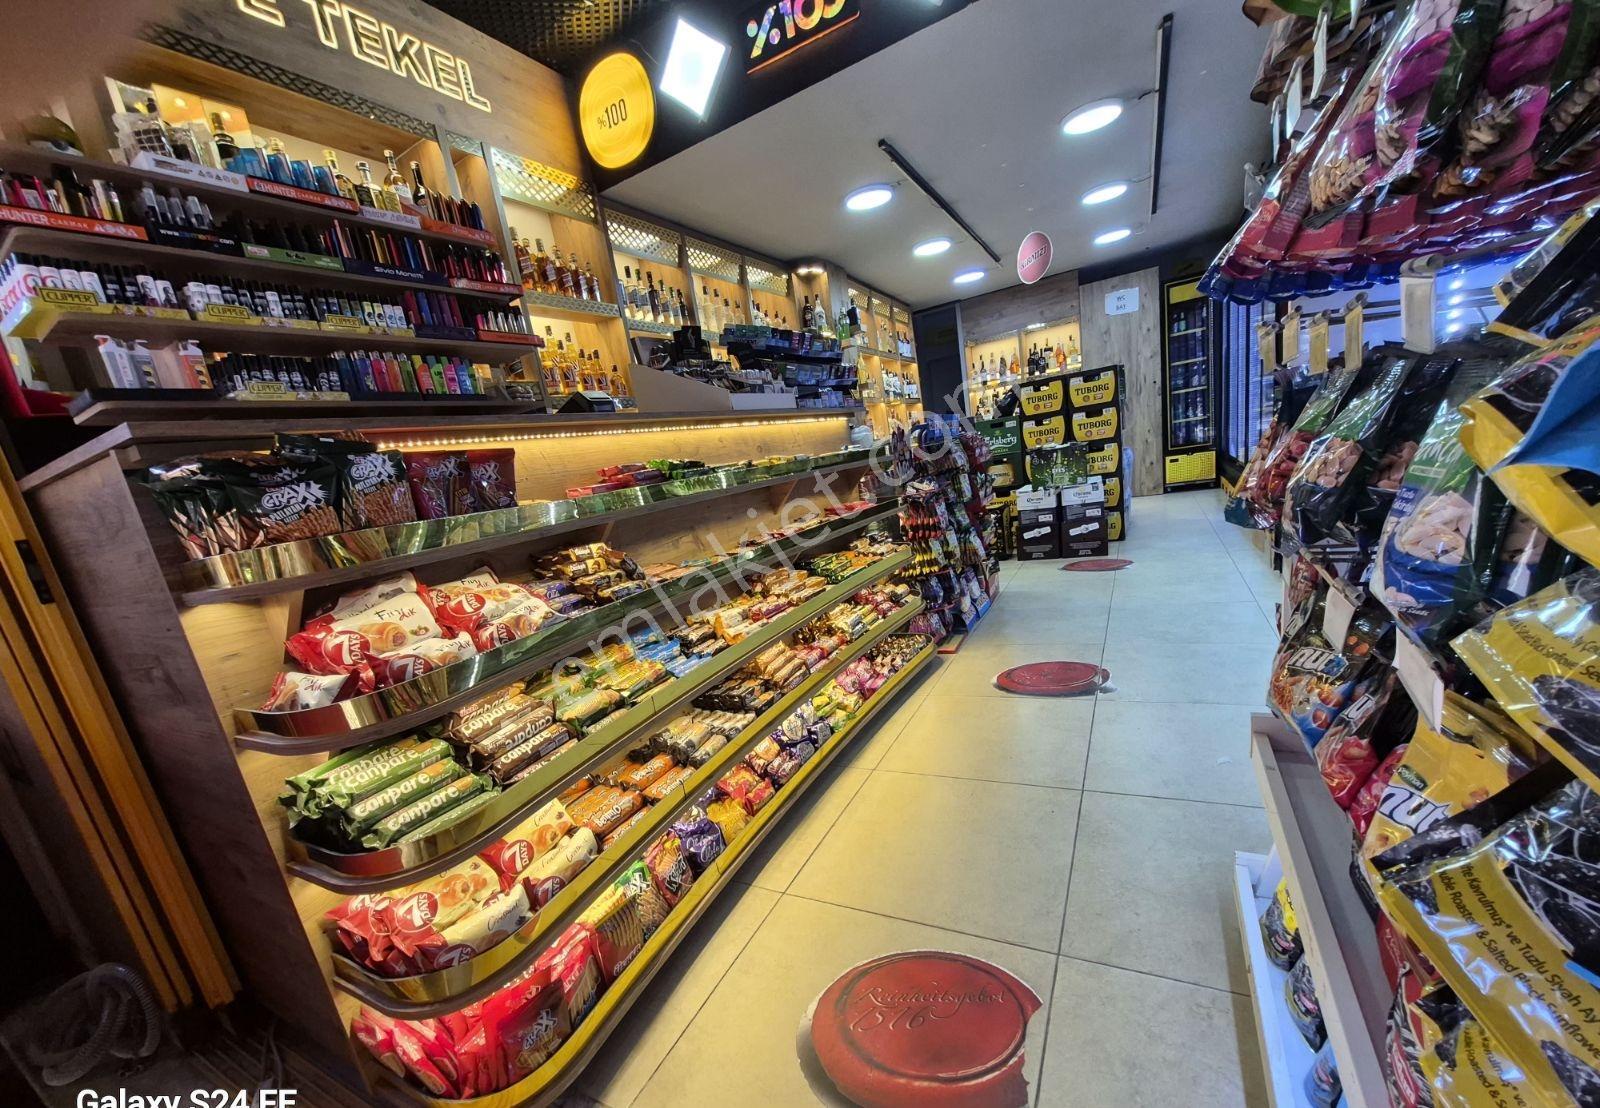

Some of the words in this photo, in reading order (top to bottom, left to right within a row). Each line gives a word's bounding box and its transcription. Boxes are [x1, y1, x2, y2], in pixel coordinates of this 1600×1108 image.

[303, 0, 492, 113] TEKEL
[597, 98, 628, 129] %100
[45, 290, 94, 304] CLIPPER
[211, 306, 247, 318] CLIPPER
[1026, 393, 1058, 404] TUBORG
[1075, 383, 1109, 396] TUBORG
[1028, 427, 1060, 438] TUBORG
[1077, 419, 1112, 431] TUBORG
[261, 480, 326, 510] CRAX
[345, 749, 418, 789] canpare
[354, 773, 430, 817] canpare
[387, 785, 459, 831] canpare
[1476, 928, 1487, 939] &
[1482, 938, 1519, 973] Salted
[1506, 929, 1521, 946] ve
[1519, 942, 1548, 975] Tuzlu
[1545, 973, 1581, 1007] Siyah
